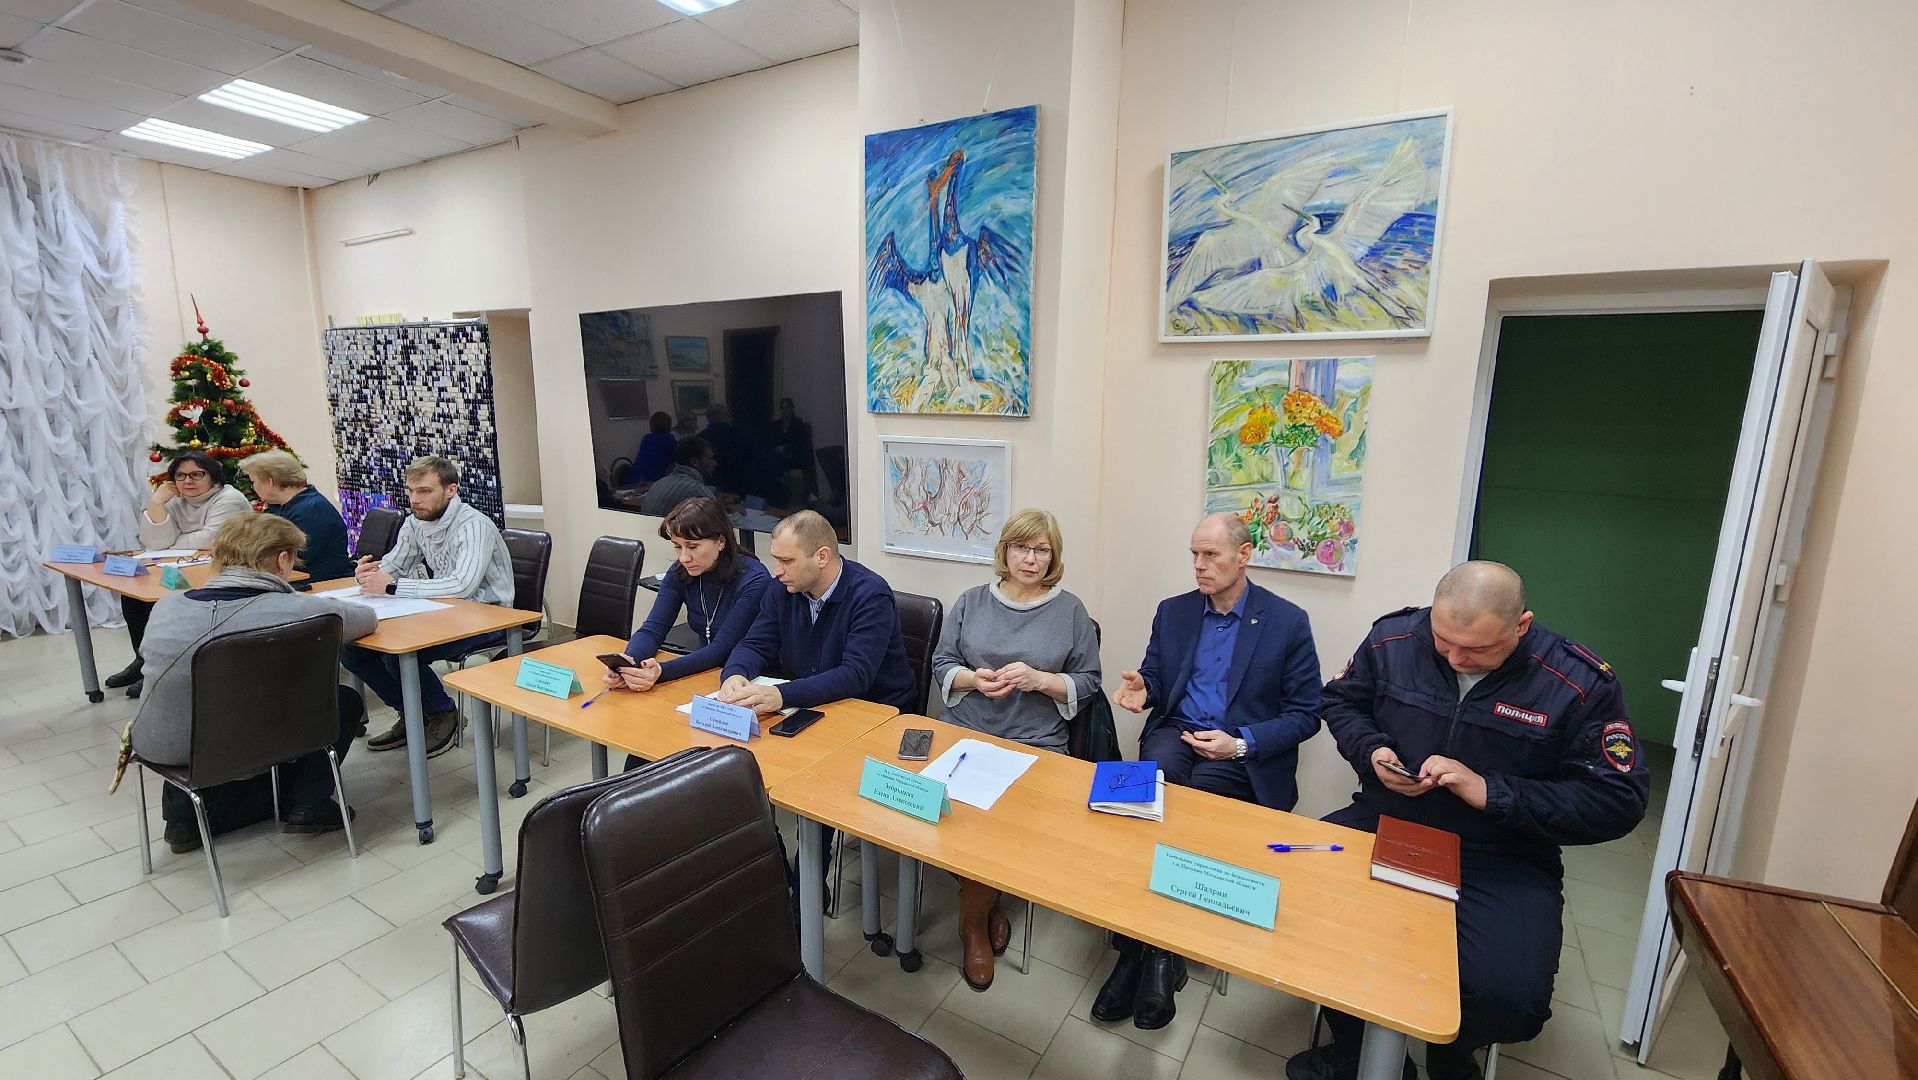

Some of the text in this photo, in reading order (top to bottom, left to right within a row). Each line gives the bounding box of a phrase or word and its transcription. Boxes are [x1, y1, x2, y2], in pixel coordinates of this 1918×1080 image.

[1497, 705, 1544, 724] ПОЛИЦИЯ
[1606, 722, 1630, 731] ПОЛИЦИЯ
[1605, 733, 1631, 743] РОССИЯ
[1170, 884, 1197, 899] Сергей
